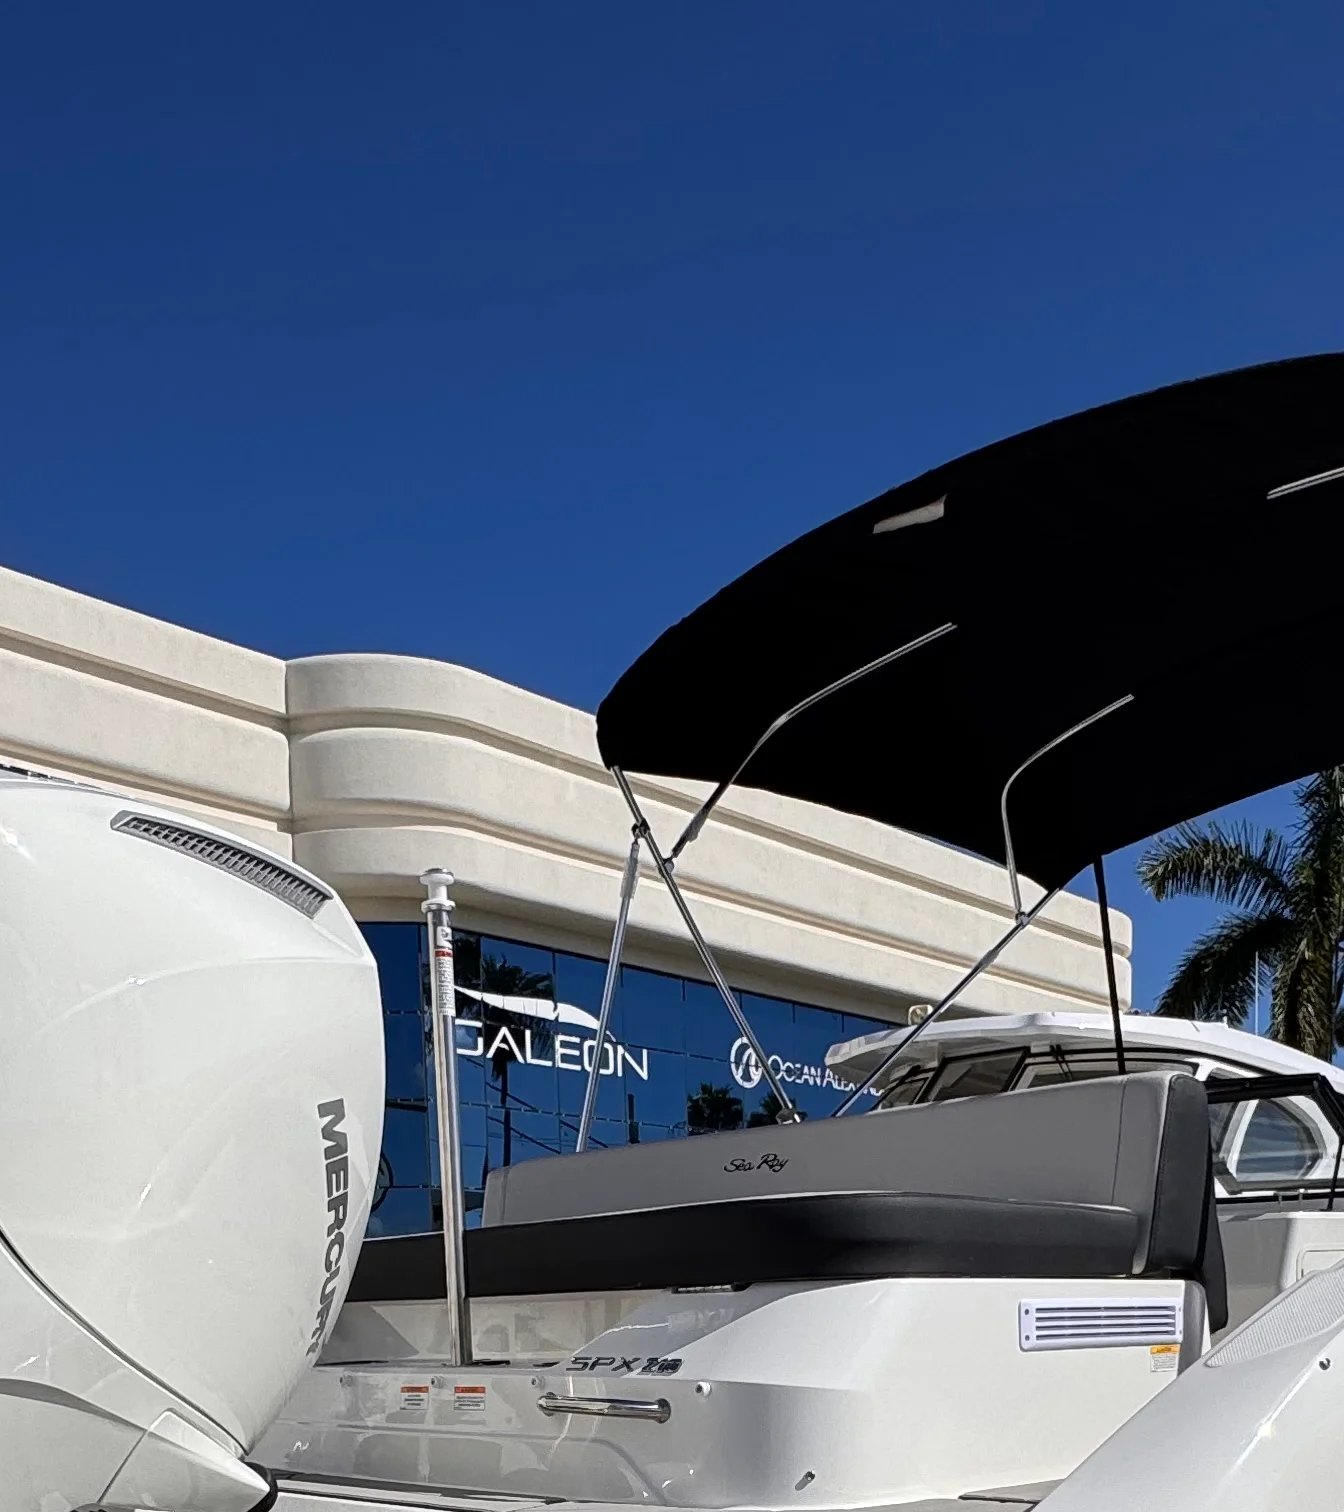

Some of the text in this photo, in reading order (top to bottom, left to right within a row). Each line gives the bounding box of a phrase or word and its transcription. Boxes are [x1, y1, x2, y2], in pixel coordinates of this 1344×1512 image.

[455, 1018, 649, 1081] GALEON
[767, 1055, 821, 1087] OCEAN
[723, 1153, 789, 1173] Sea Ray
[566, 1356, 641, 1372] SPX
